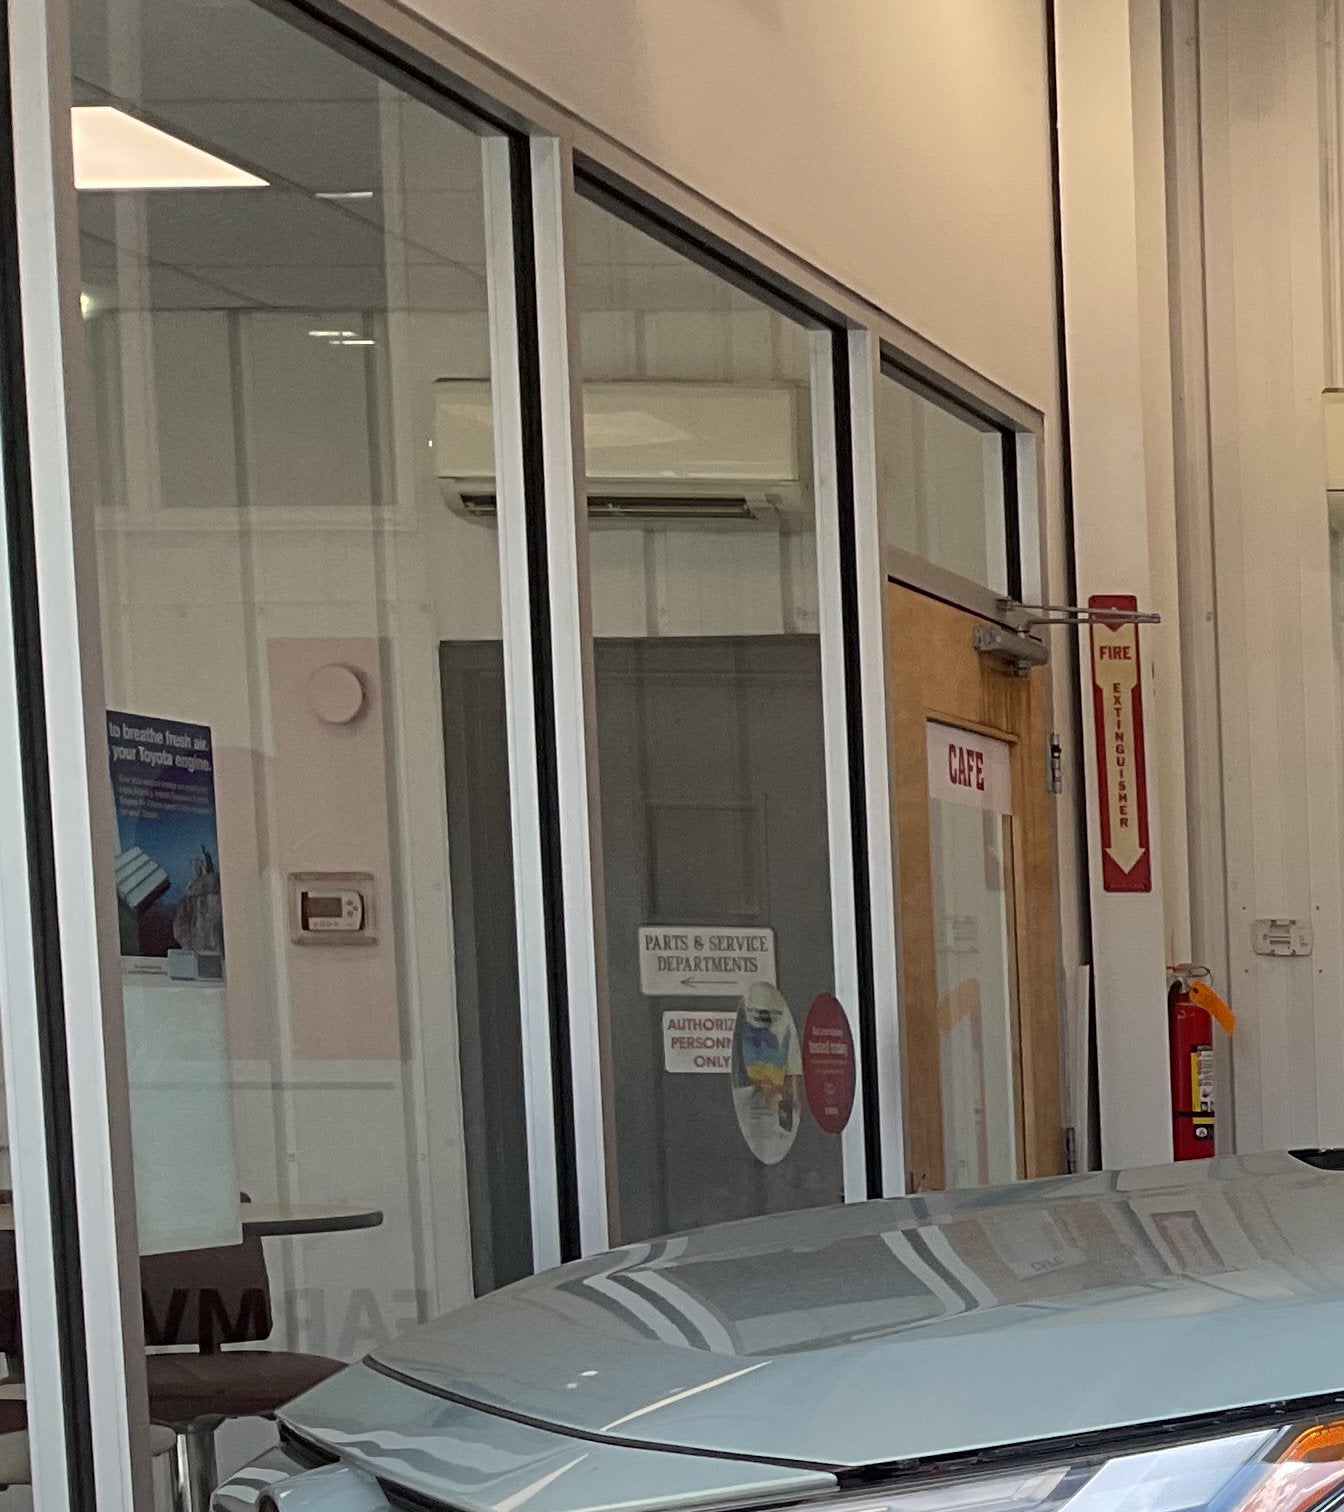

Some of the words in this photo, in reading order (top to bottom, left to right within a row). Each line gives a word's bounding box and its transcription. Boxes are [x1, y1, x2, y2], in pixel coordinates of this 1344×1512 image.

[1099, 645, 1132, 660] FIRE
[109, 721, 121, 738] to
[122, 722, 164, 745] breathe
[165, 729, 192, 749] fresh
[111, 745, 137, 761] your
[138, 745, 174, 767] Toyota
[174, 754, 212, 773] engine.
[1112, 682, 1130, 828] EXTINGUISHER
[948, 743, 985, 791] CAFE
[645, 934, 690, 952] PARTS
[693, 936, 705, 951] &
[708, 935, 769, 953] SERVICE
[657, 956, 759, 973] DEPARTMENTS
[667, 1018, 735, 1031] AUTHORIZ
[671, 1036, 733, 1050] PERSONN
[693, 1055, 731, 1068] ONLY
